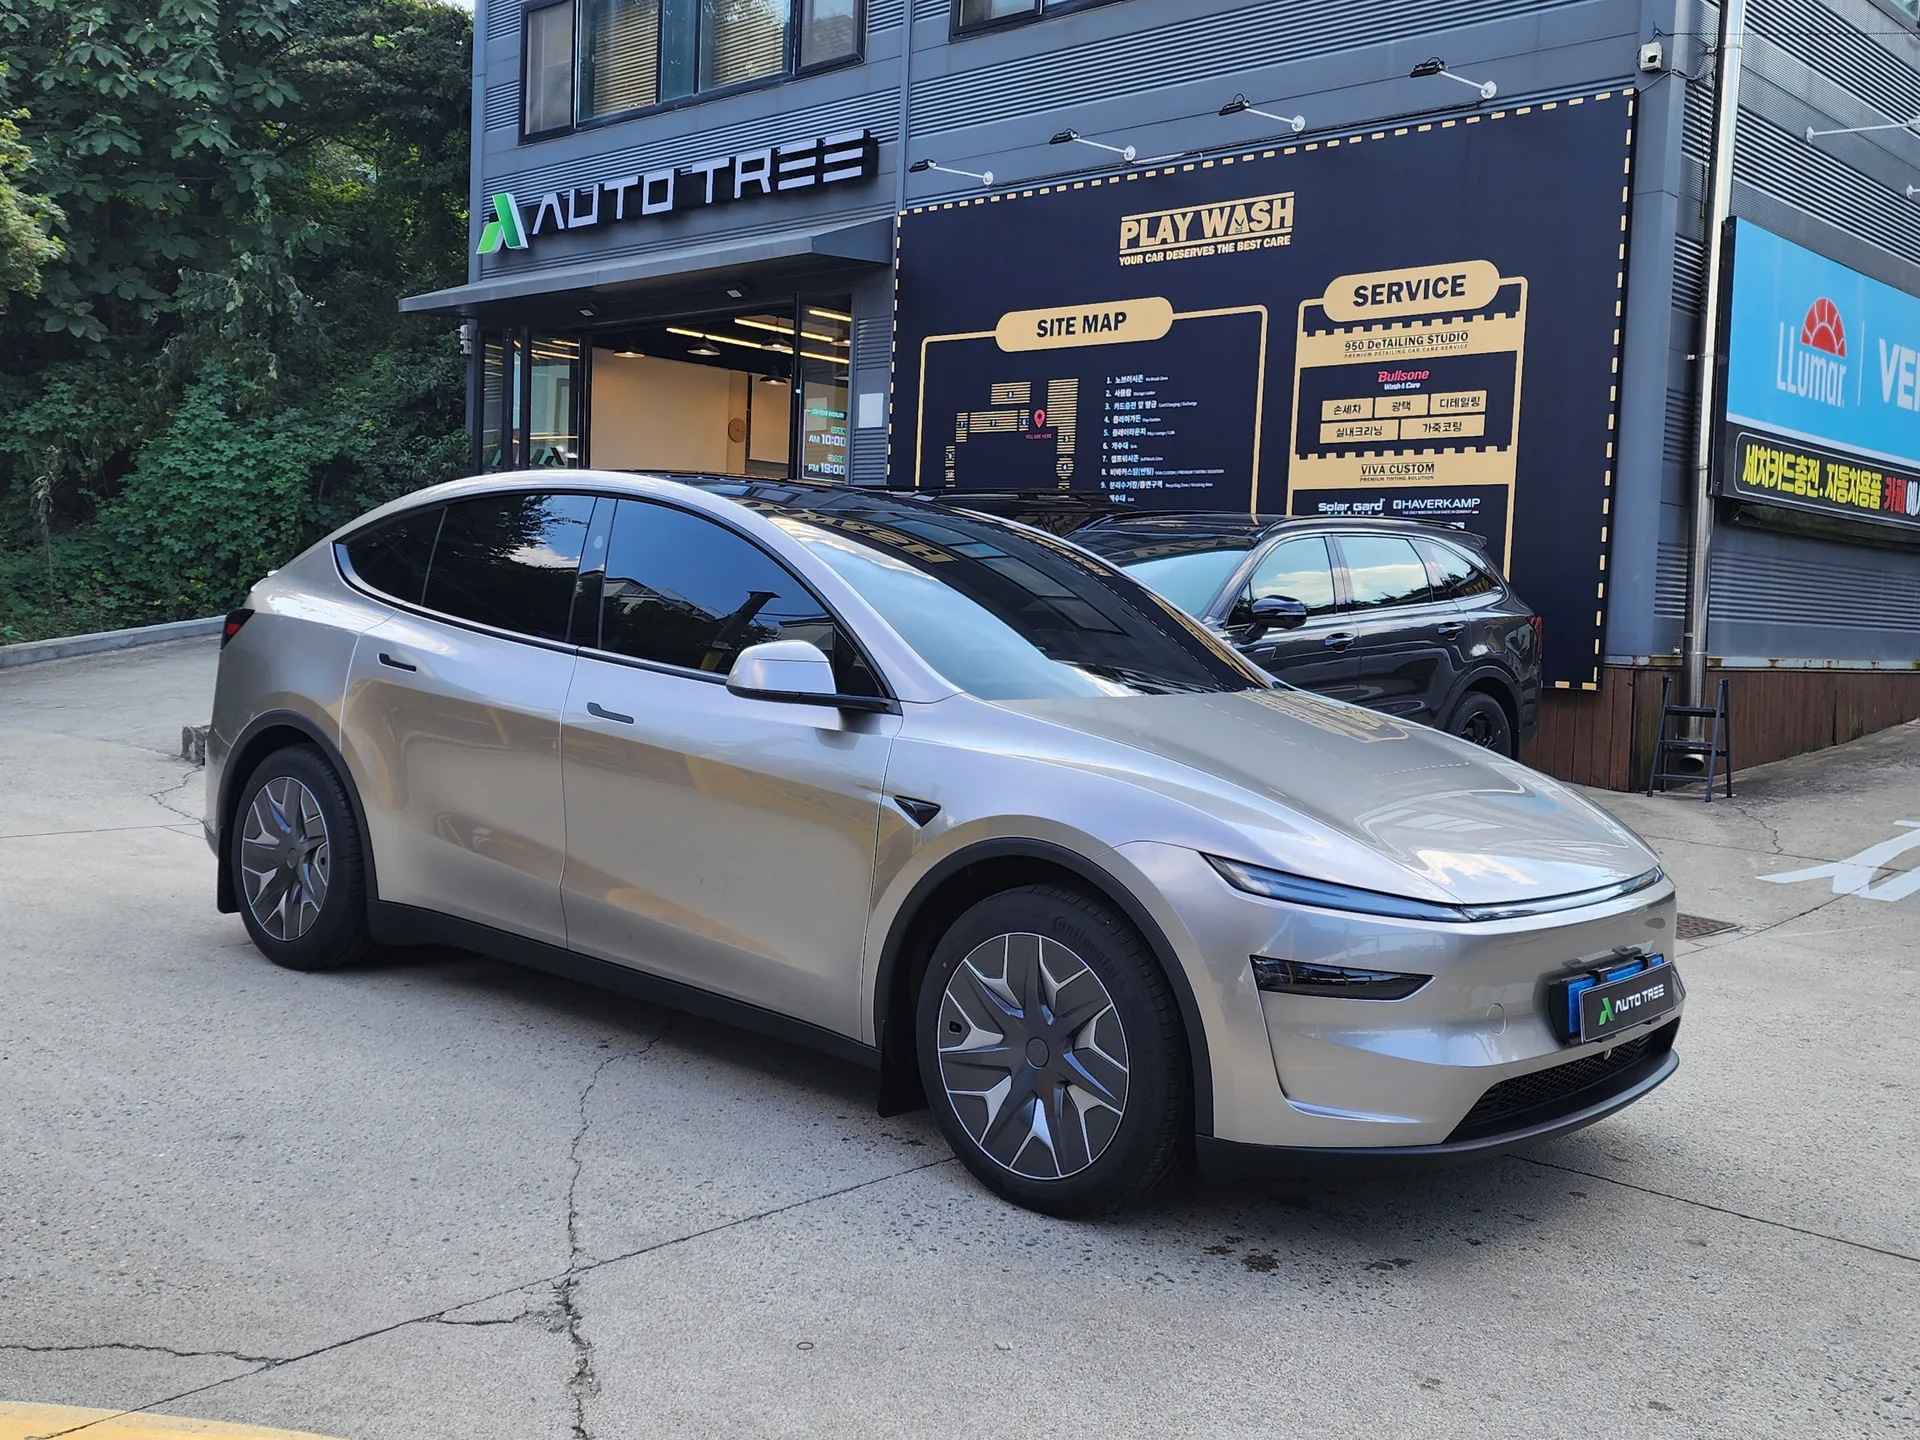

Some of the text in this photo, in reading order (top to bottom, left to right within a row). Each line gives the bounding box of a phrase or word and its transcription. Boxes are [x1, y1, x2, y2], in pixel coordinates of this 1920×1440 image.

[532, 129, 865, 234] AUTO TREE
[1120, 197, 1294, 249] PLAY WASH
[1119, 235, 1291, 266] YOUR CAR DESERVES THE BEST CARE
[1352, 274, 1467, 308] SERVICE
[1036, 312, 1127, 338] SITE MAP
[1345, 340, 1364, 351] 950
[1427, 332, 1469, 345] STUDIO
[1374, 349, 1406, 357] DETAILING
[1441, 343, 1468, 351] SERVICE
[1776, 322, 1848, 408] LLumar
[1377, 370, 1430, 383] Bullsone
[1391, 401, 1412, 412] 광택
[1439, 396, 1481, 409] 디테일링
[811, 409, 828, 417] OPEN
[1333, 404, 1361, 416] 손세차
[1336, 425, 1383, 438] 실내크리닝
[1422, 421, 1463, 434] 가죽코팅
[808, 434, 846, 446] AM 10:00
[821, 462, 845, 475] 19:00
[1361, 463, 1435, 475] VIVA CUSTOM
[1742, 443, 1824, 499] 세차카드충전,
[1824, 463, 1883, 511] 자동차용품
[1318, 498, 1383, 512] Solar Gard
[1402, 497, 1481, 510] HAVERKAMP
[1615, 984, 1665, 1013] AUTO TREE
